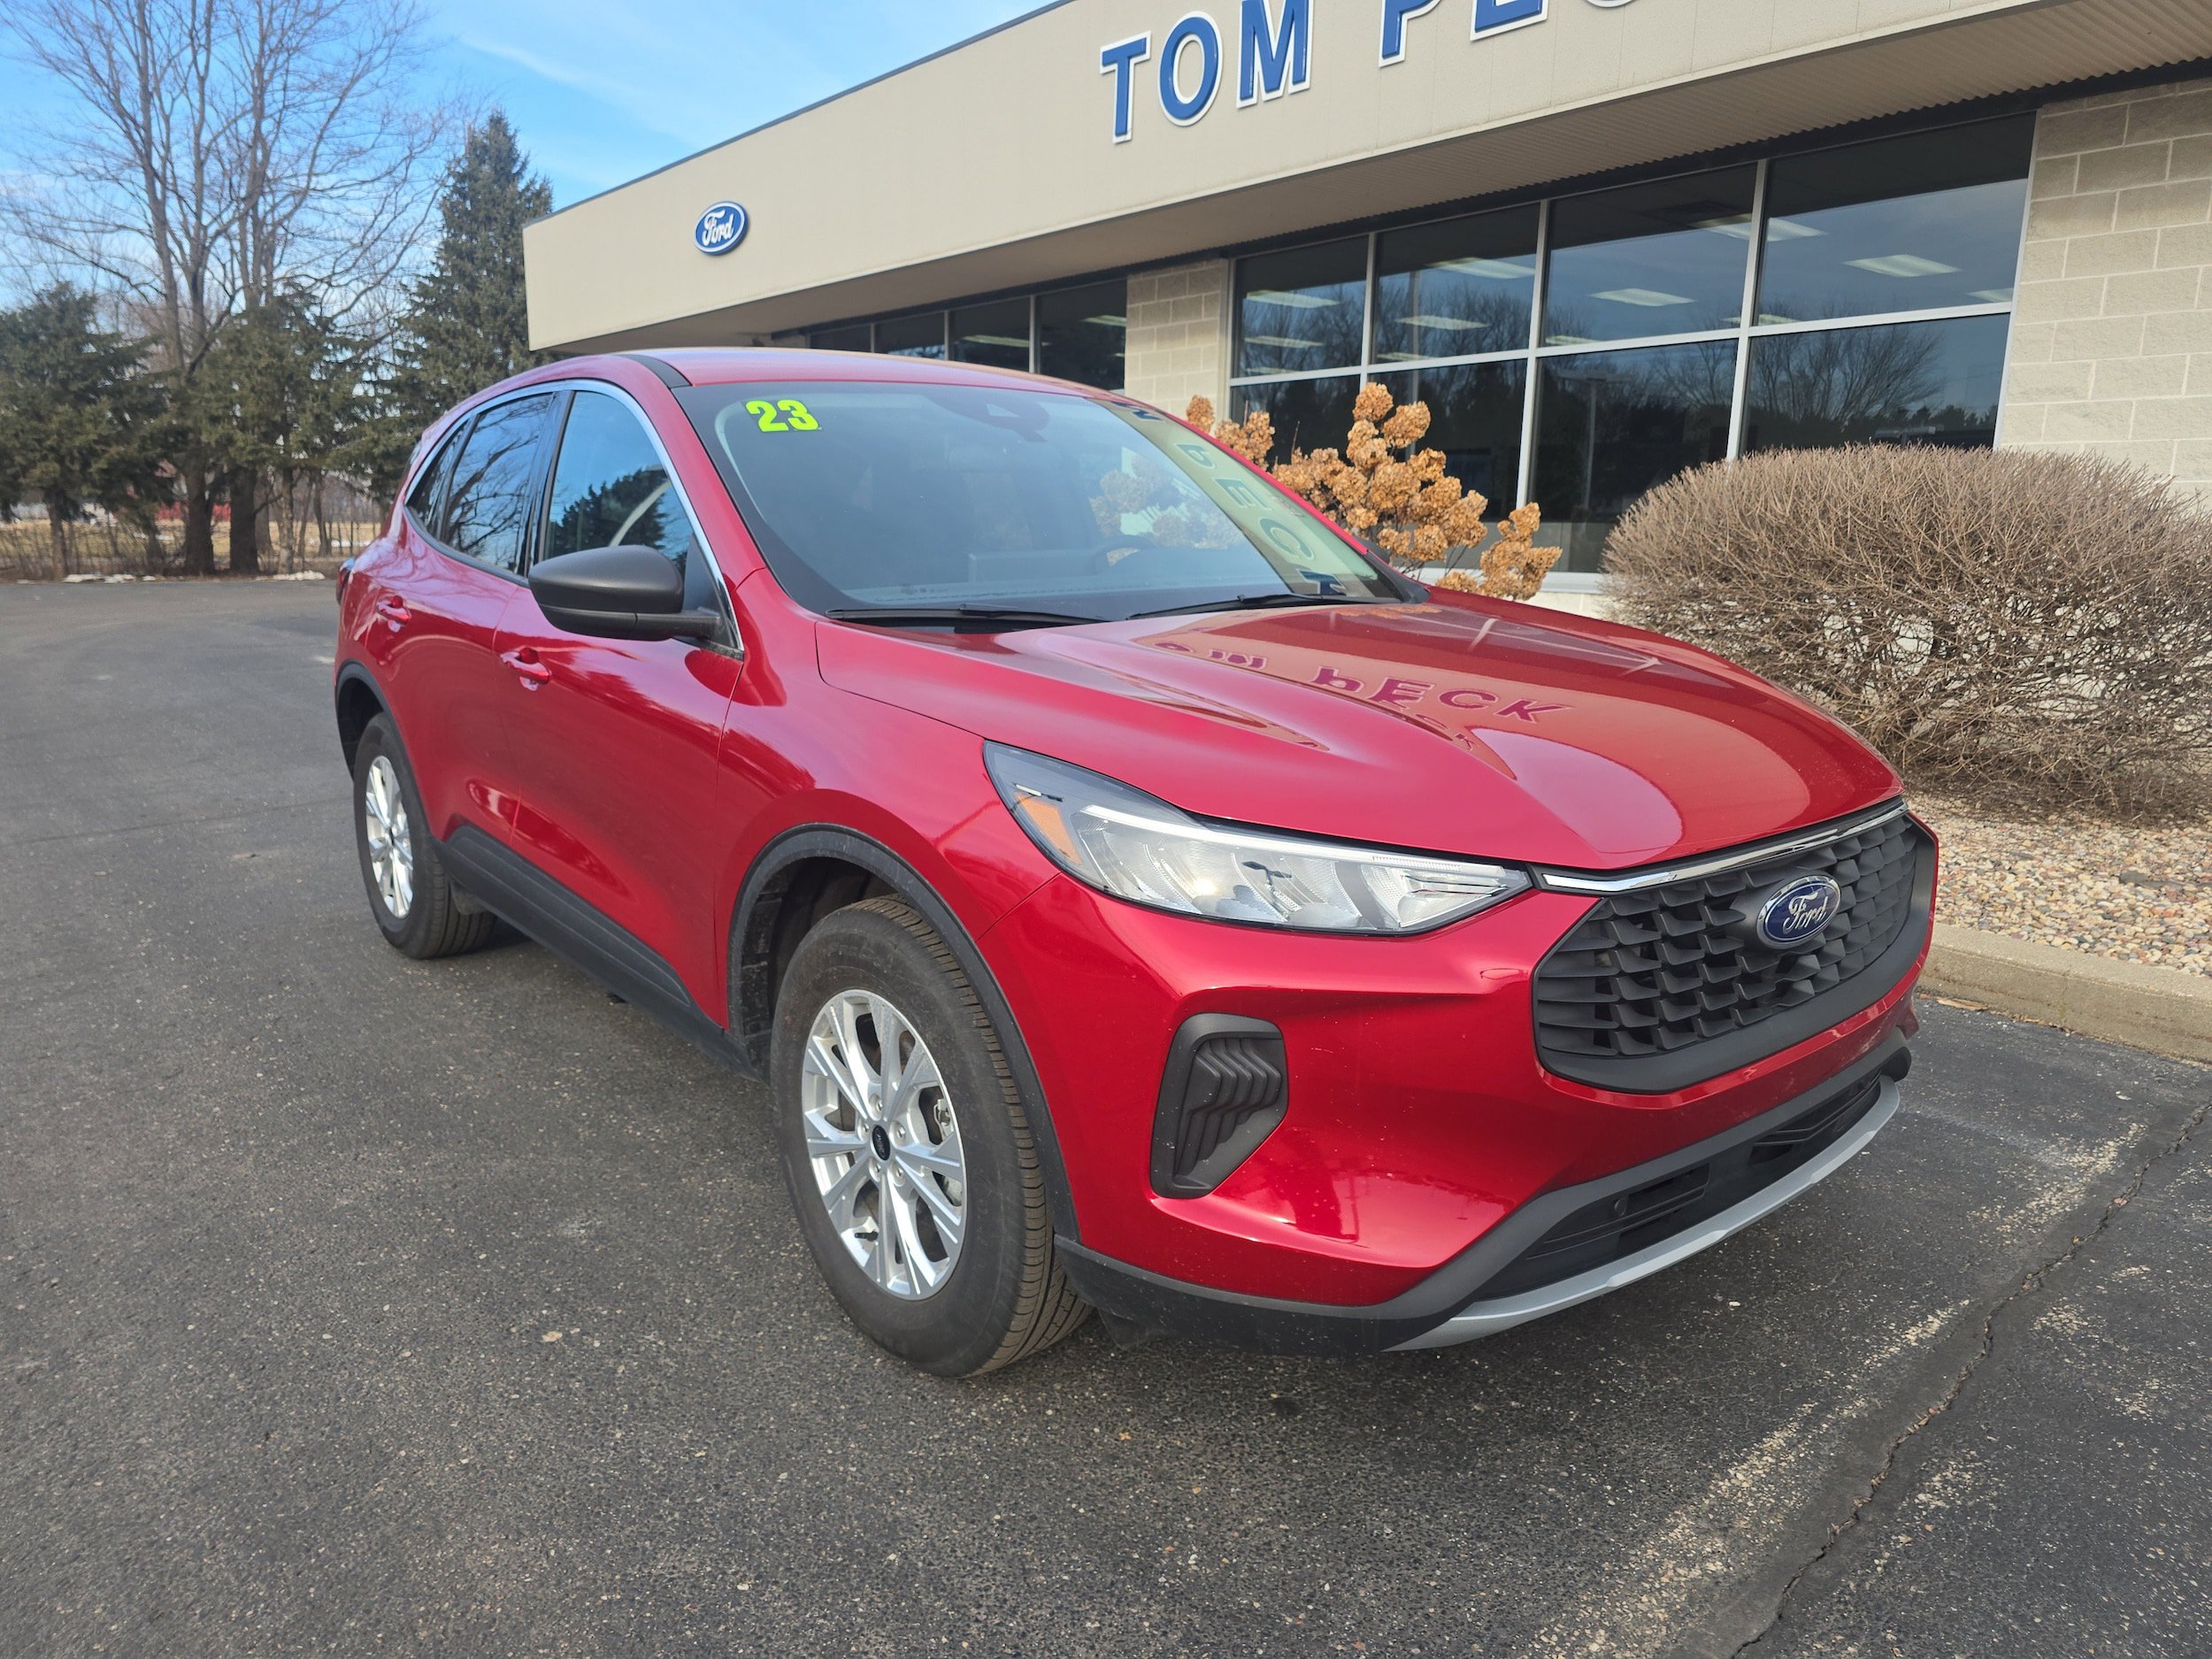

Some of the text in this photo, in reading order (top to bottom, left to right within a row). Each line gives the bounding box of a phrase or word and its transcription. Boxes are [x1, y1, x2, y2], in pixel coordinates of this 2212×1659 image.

[1100, 0, 1314, 143] TOM
[702, 209, 734, 248] Ford
[745, 399, 820, 433] 23
[1782, 891, 1829, 935] Ford
